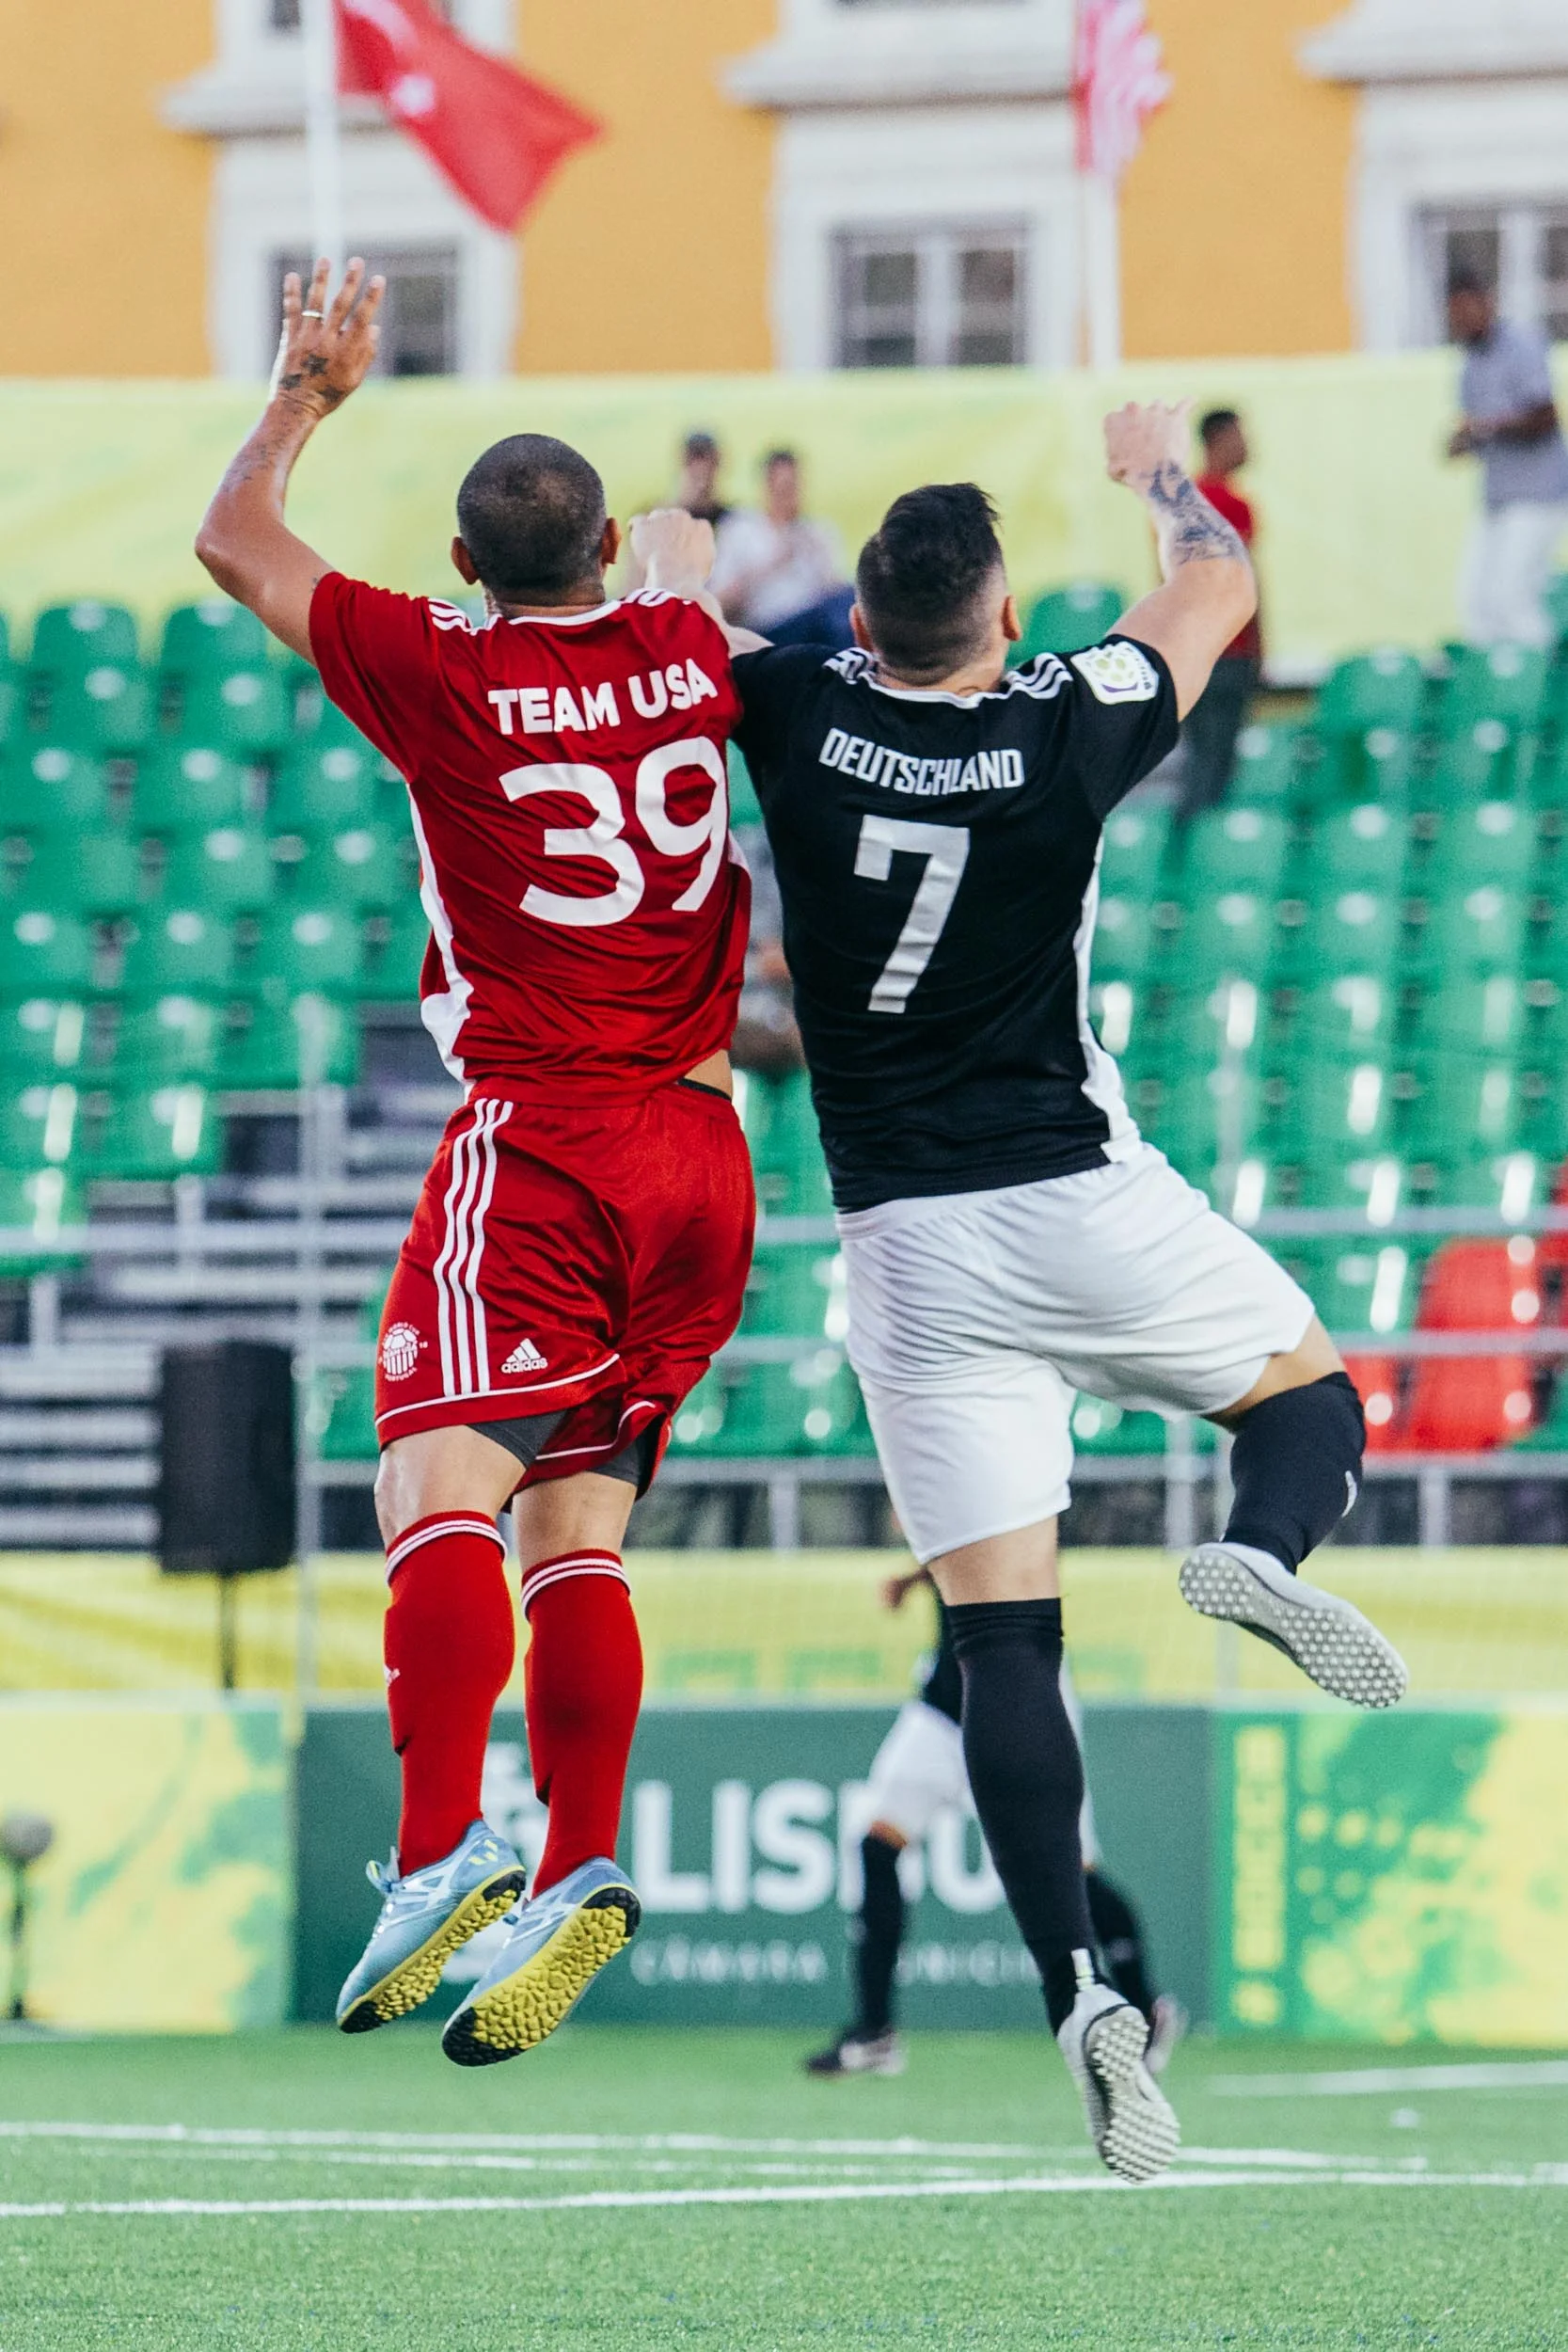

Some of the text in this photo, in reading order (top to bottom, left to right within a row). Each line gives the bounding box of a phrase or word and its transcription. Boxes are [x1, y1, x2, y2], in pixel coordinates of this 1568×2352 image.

[488, 658, 719, 736] TEAM USA
[817, 726, 1026, 796] DEUTSCHLAND
[499, 735, 728, 927] 39
[853, 814, 971, 1014] 7
[500, 1357, 548, 1375] adidas
